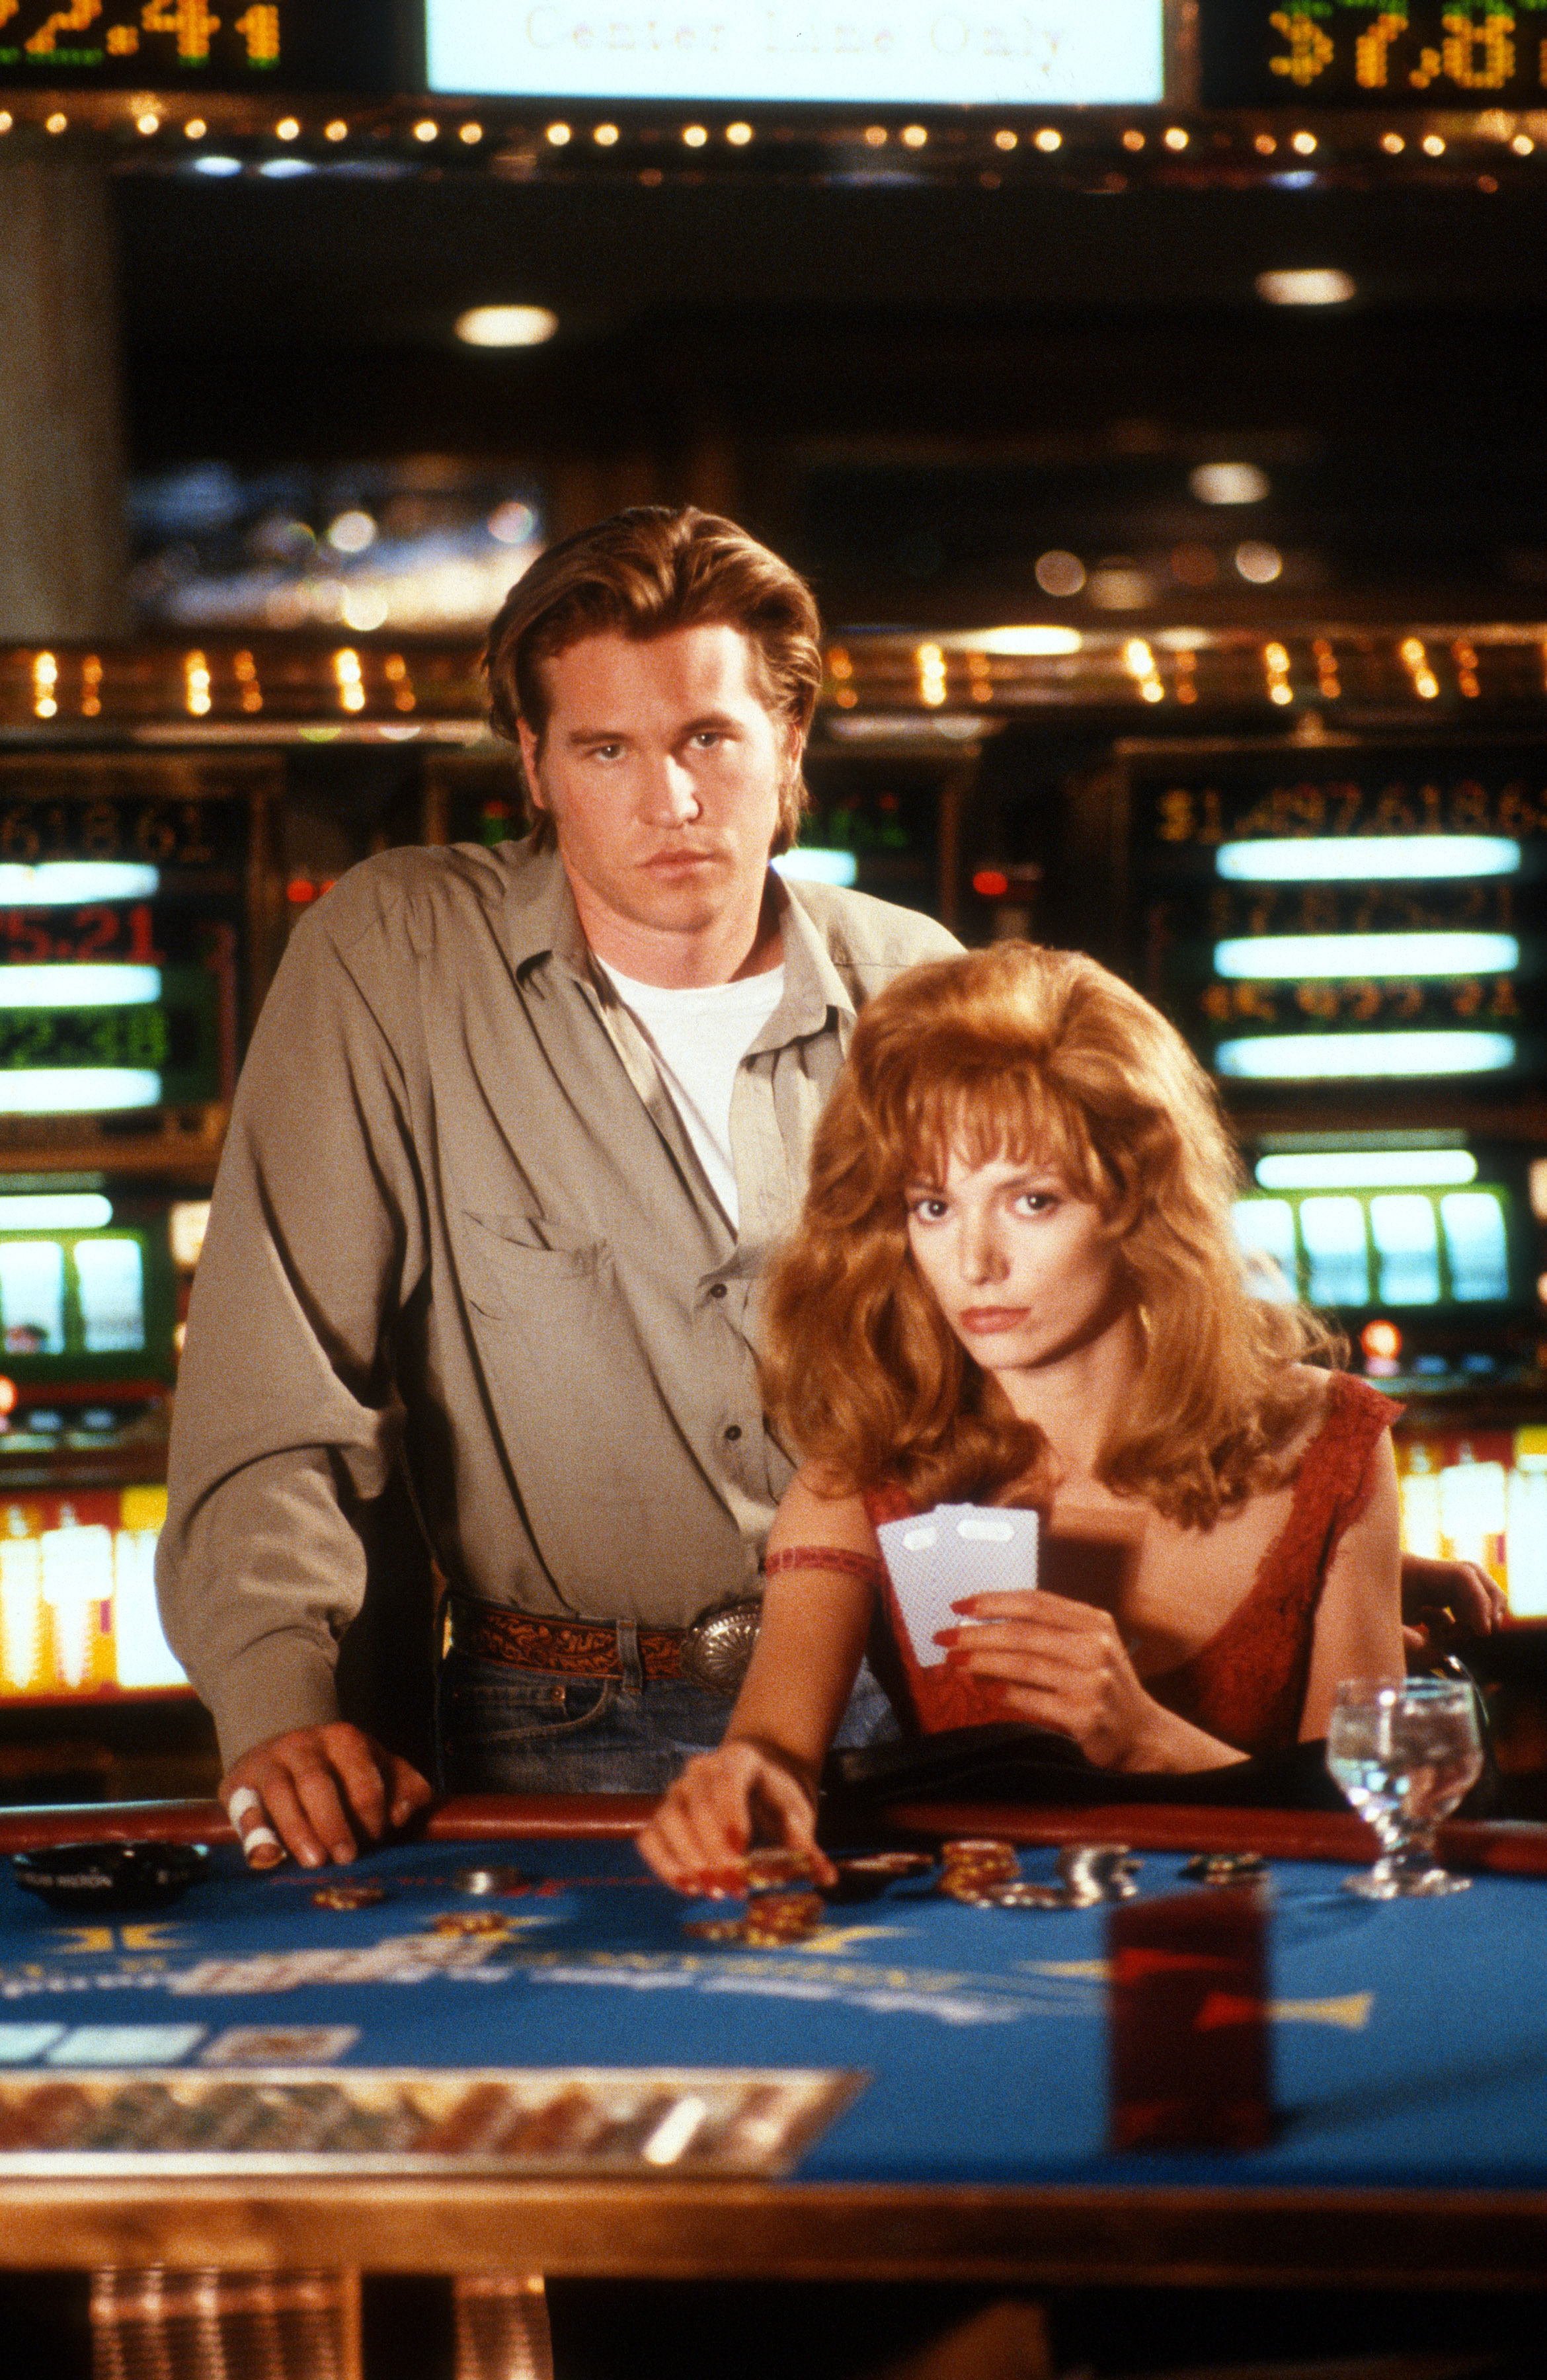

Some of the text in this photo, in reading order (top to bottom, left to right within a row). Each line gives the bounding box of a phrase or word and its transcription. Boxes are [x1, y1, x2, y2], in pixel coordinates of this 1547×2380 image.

[524, 3, 1066, 76] Center Line Only
